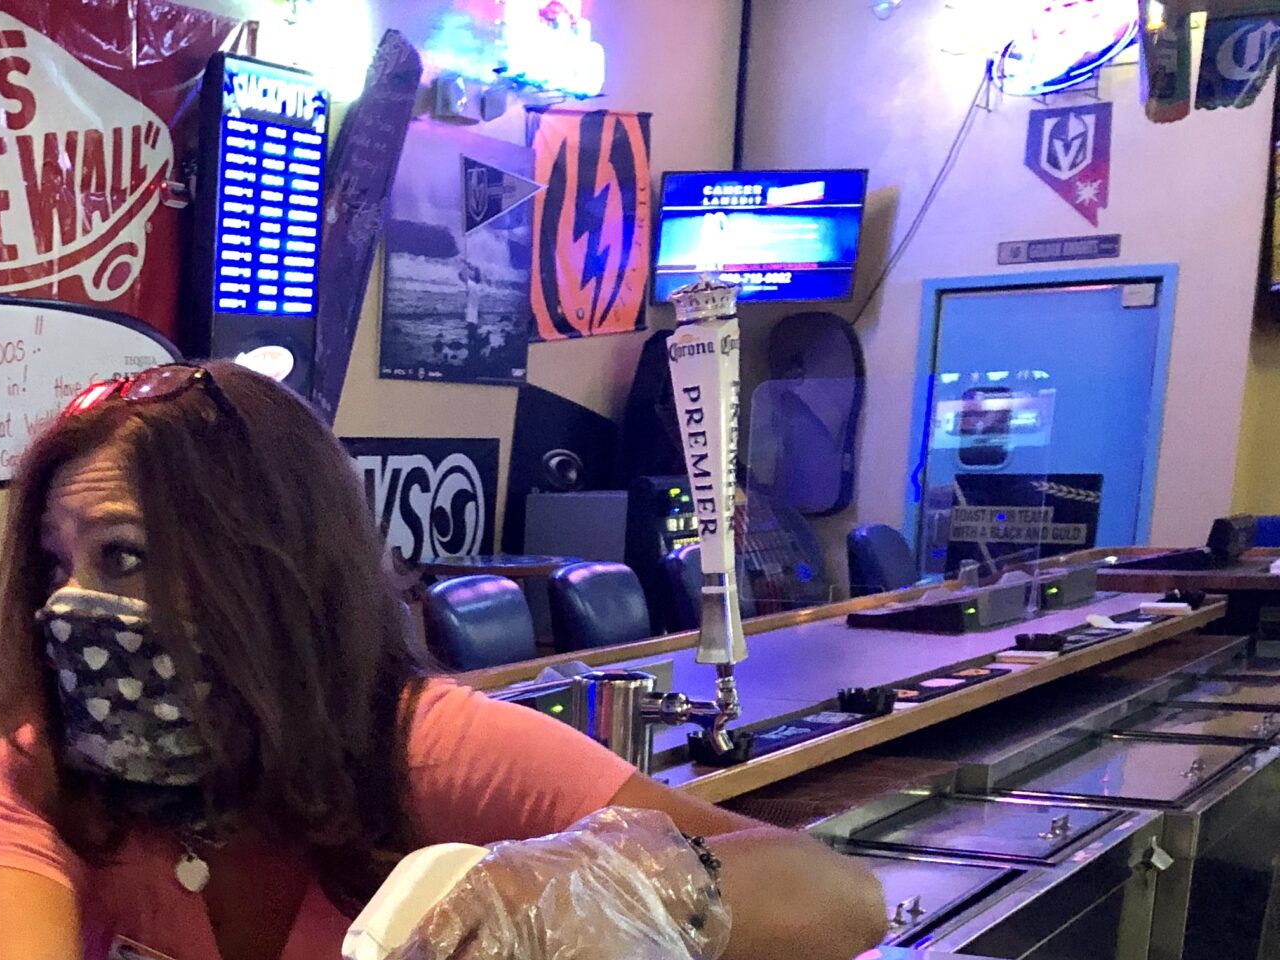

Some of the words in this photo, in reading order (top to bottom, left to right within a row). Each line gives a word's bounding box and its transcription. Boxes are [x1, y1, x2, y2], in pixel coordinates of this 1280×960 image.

[702, 184, 763, 196] CANCER
[669, 341, 716, 363] Corona
[682, 385, 718, 536] PREMIER
[954, 507, 986, 523] TOAST
[1019, 508, 1051, 524] TEAM
[951, 524, 977, 539] WITH
[979, 525, 987, 539] A
[1026, 526, 1049, 541] AND
[1052, 526, 1082, 541] GOLD
